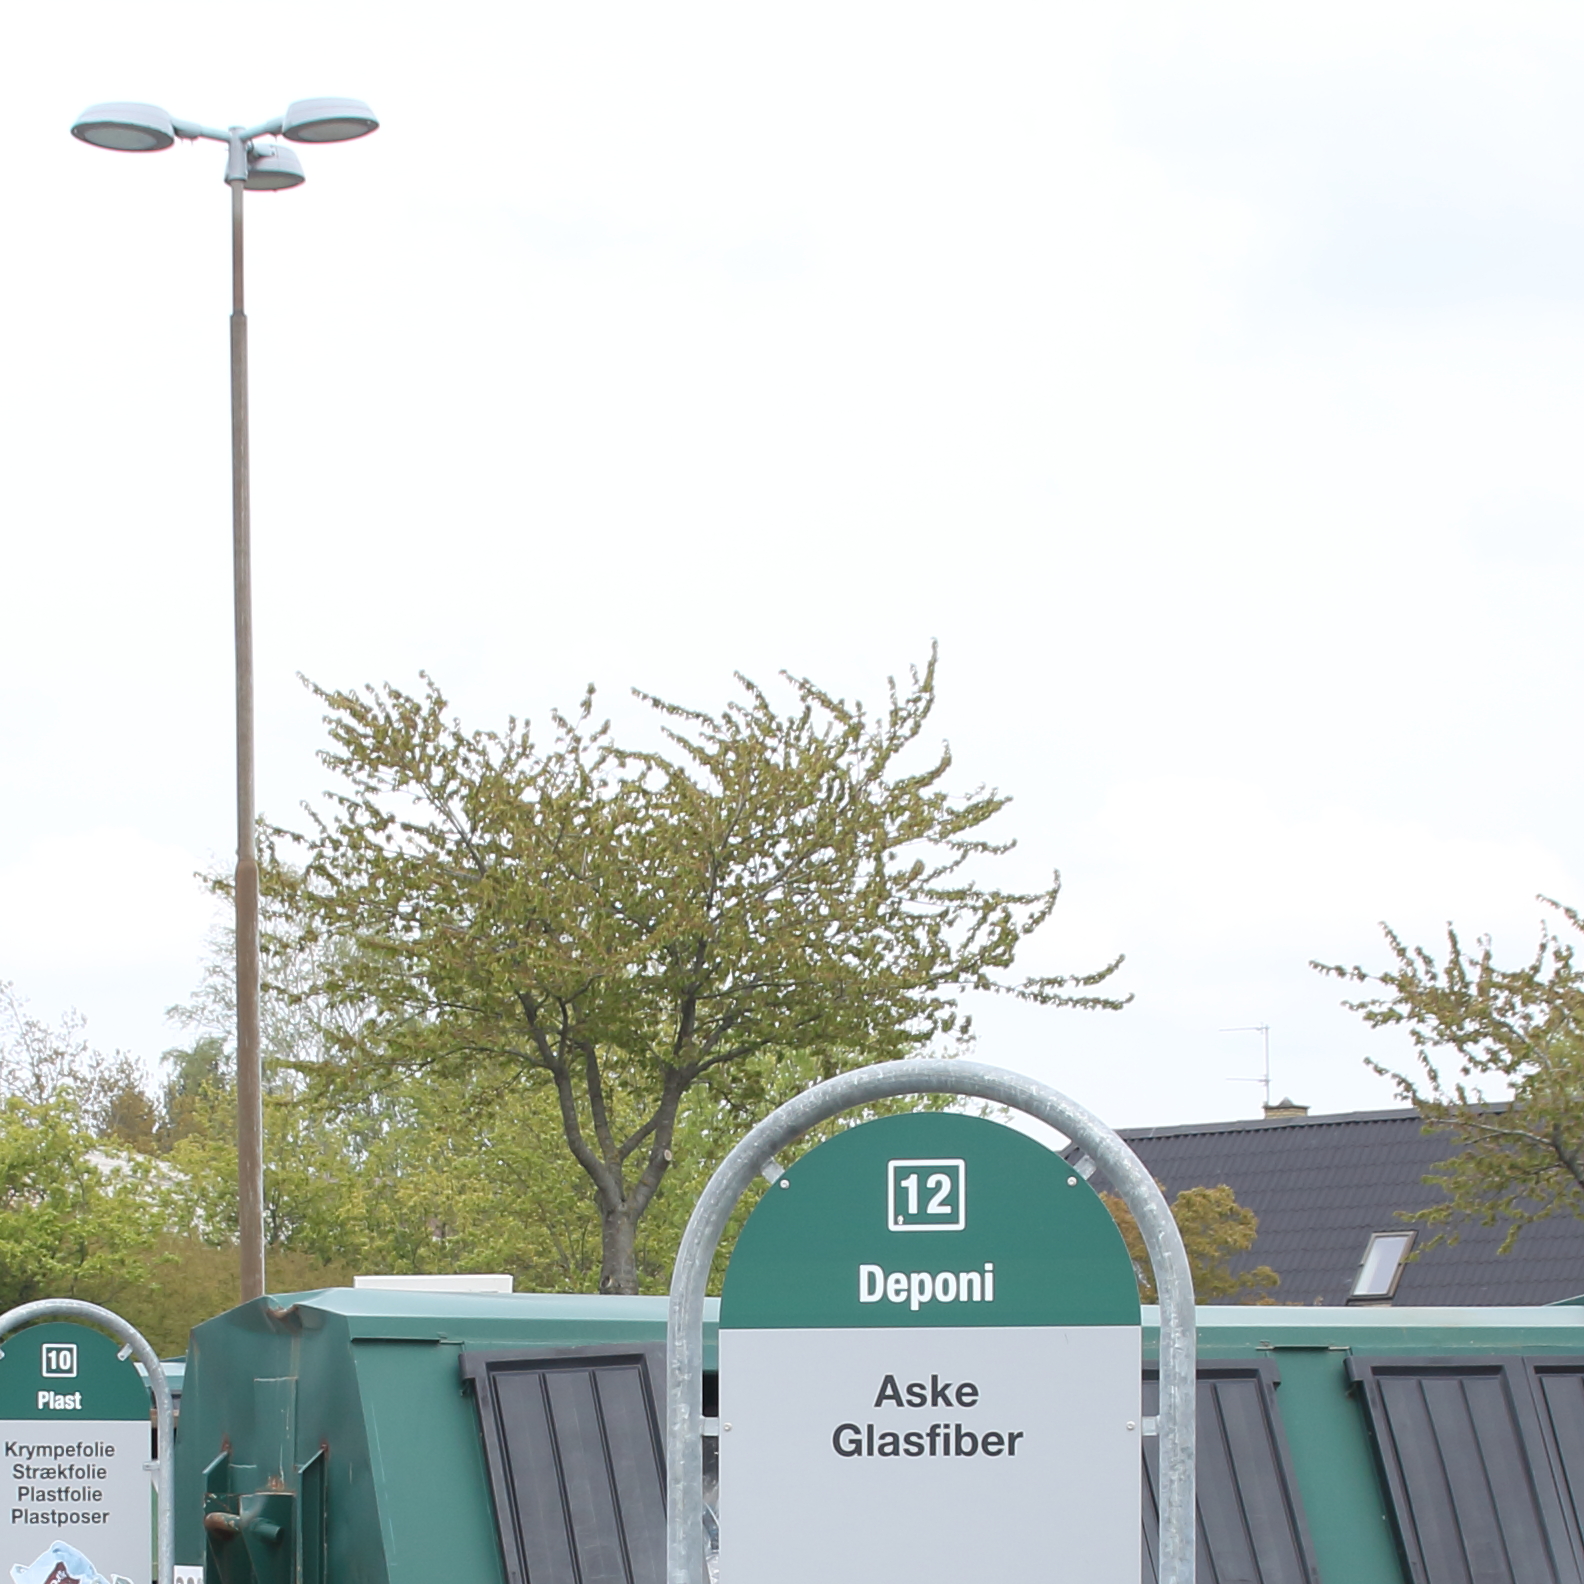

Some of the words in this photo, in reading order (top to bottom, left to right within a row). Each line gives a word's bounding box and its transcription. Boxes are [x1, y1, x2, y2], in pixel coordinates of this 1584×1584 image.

[899, 1172, 953, 1215] 12
[859, 1262, 995, 1311] Deponi
[47, 1350, 72, 1370] 10
[36, 1390, 83, 1410] Plast
[874, 1374, 980, 1408] Aske
[832, 1422, 1024, 1458] Glasfiber
[4, 1441, 116, 1460] Krympefolie
[12, 1463, 108, 1480] Strækfolie
[17, 1485, 104, 1502] Plastfolie
[11, 1508, 110, 1528] Plastposer
